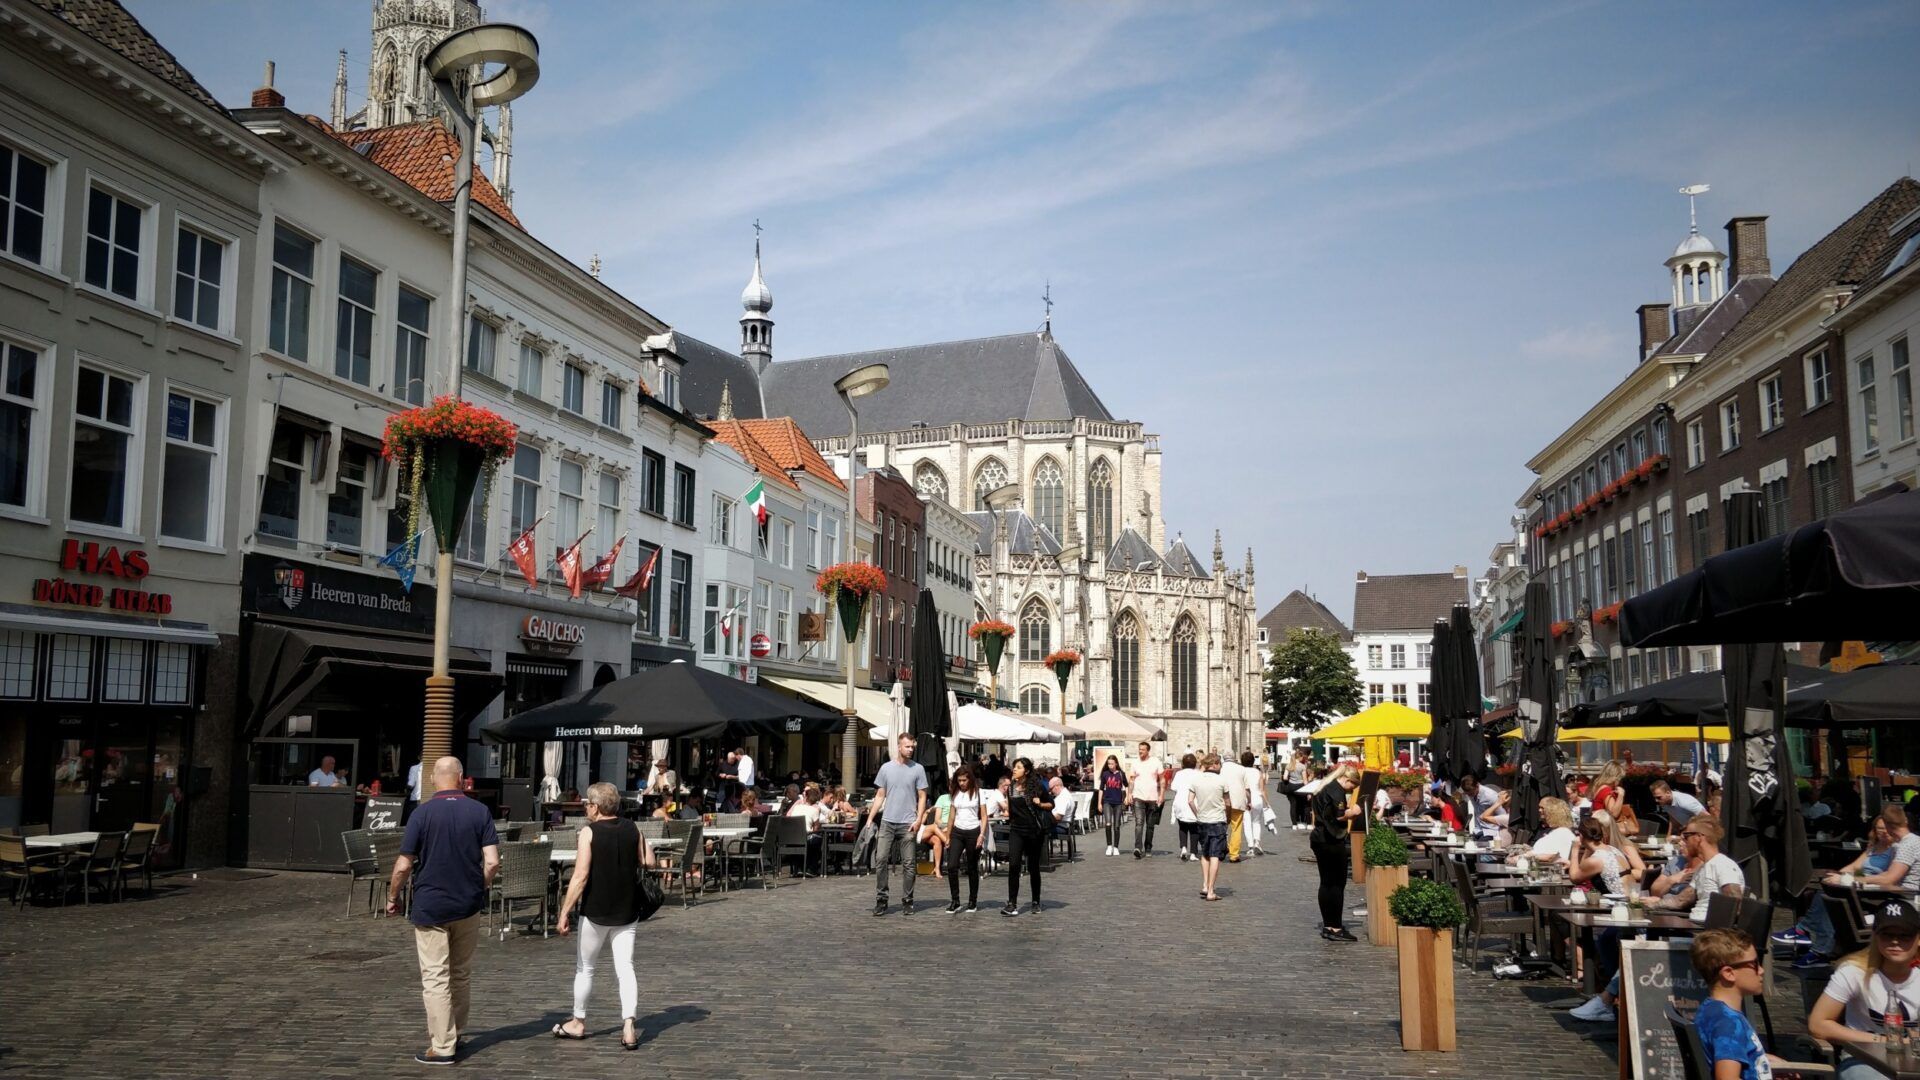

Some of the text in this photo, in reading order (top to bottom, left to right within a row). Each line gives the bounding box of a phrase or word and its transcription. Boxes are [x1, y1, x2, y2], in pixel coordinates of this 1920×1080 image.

[61, 539, 149, 581] HAS
[35, 577, 172, 614] DÖNER KEBAB
[311, 582, 412, 613] Heeren van Breda
[528, 615, 586, 643] GAUCHOS
[555, 724, 643, 737] Heeren van Breda
[1639, 962, 1697, 990] Lunch
